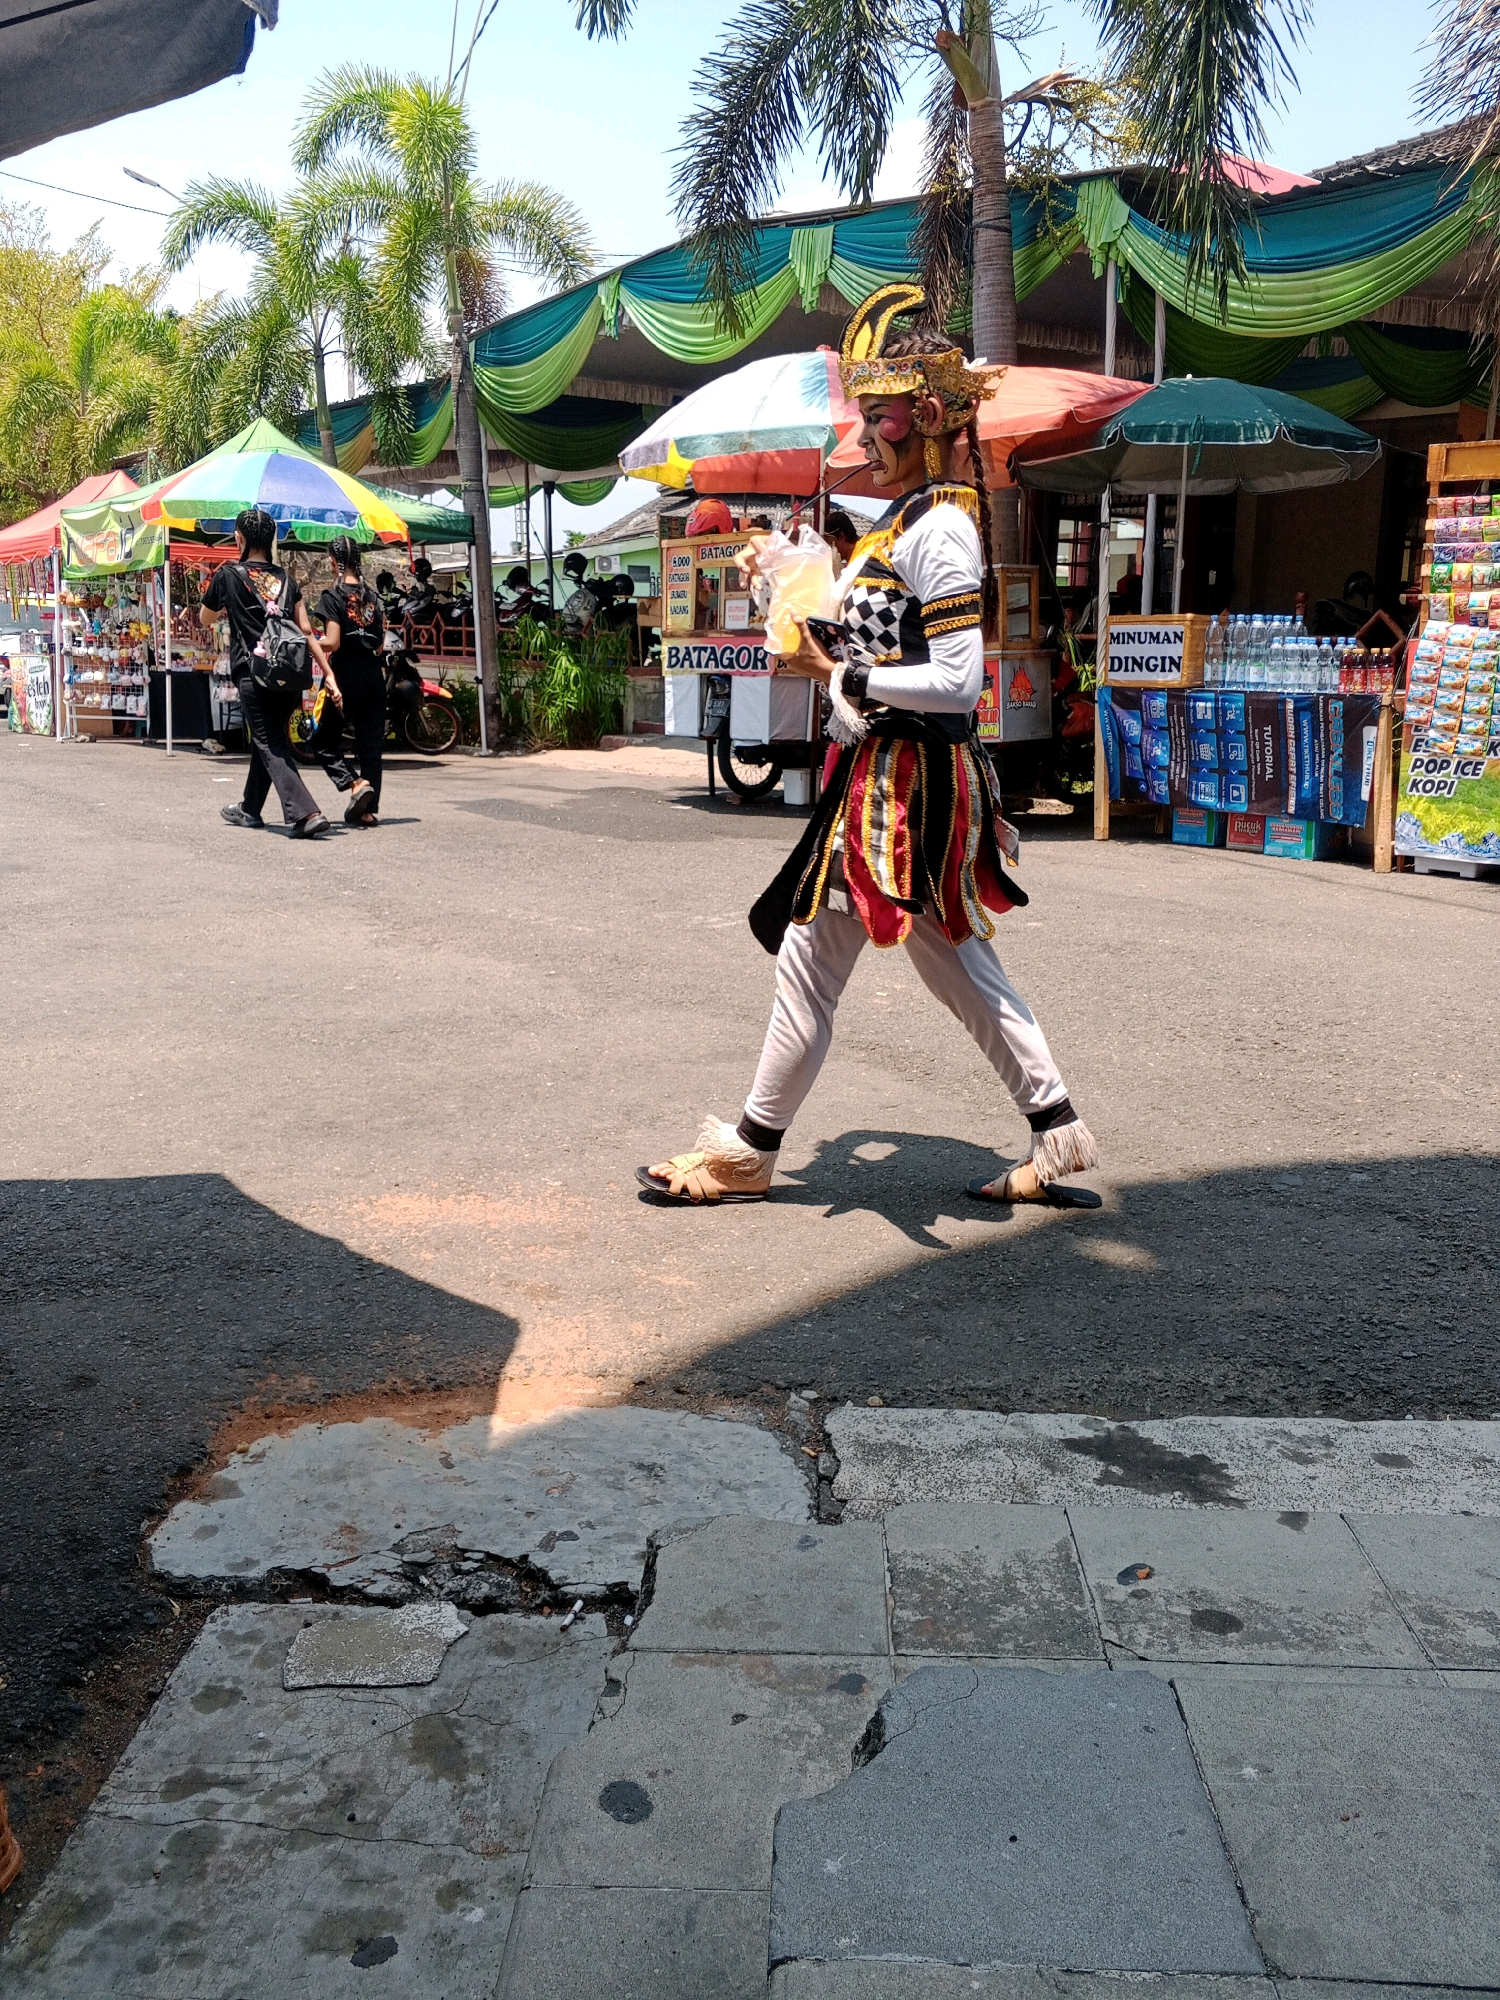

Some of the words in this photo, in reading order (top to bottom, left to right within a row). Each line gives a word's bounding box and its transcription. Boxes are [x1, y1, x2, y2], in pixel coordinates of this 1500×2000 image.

[1109, 631, 1184, 645] MINUMAN
[666, 645, 769, 670] BATAGOR
[1108, 655, 1183, 673] DINGIN
[1006, 701, 1021, 710] BAKSO
[1022, 700, 1038, 709] BAKAR
[1286, 698, 1295, 739] MUDAH
[1263, 725, 1273, 781] TUTORIAL
[1288, 739, 1297, 774] CEPAT
[1329, 699, 1344, 820] CASHLESS
[1410, 757, 1452, 775] POP
[1453, 760, 1485, 777] ICE
[1287, 773, 1297, 815] EFISIEN
[1408, 778, 1456, 795] KOPI
